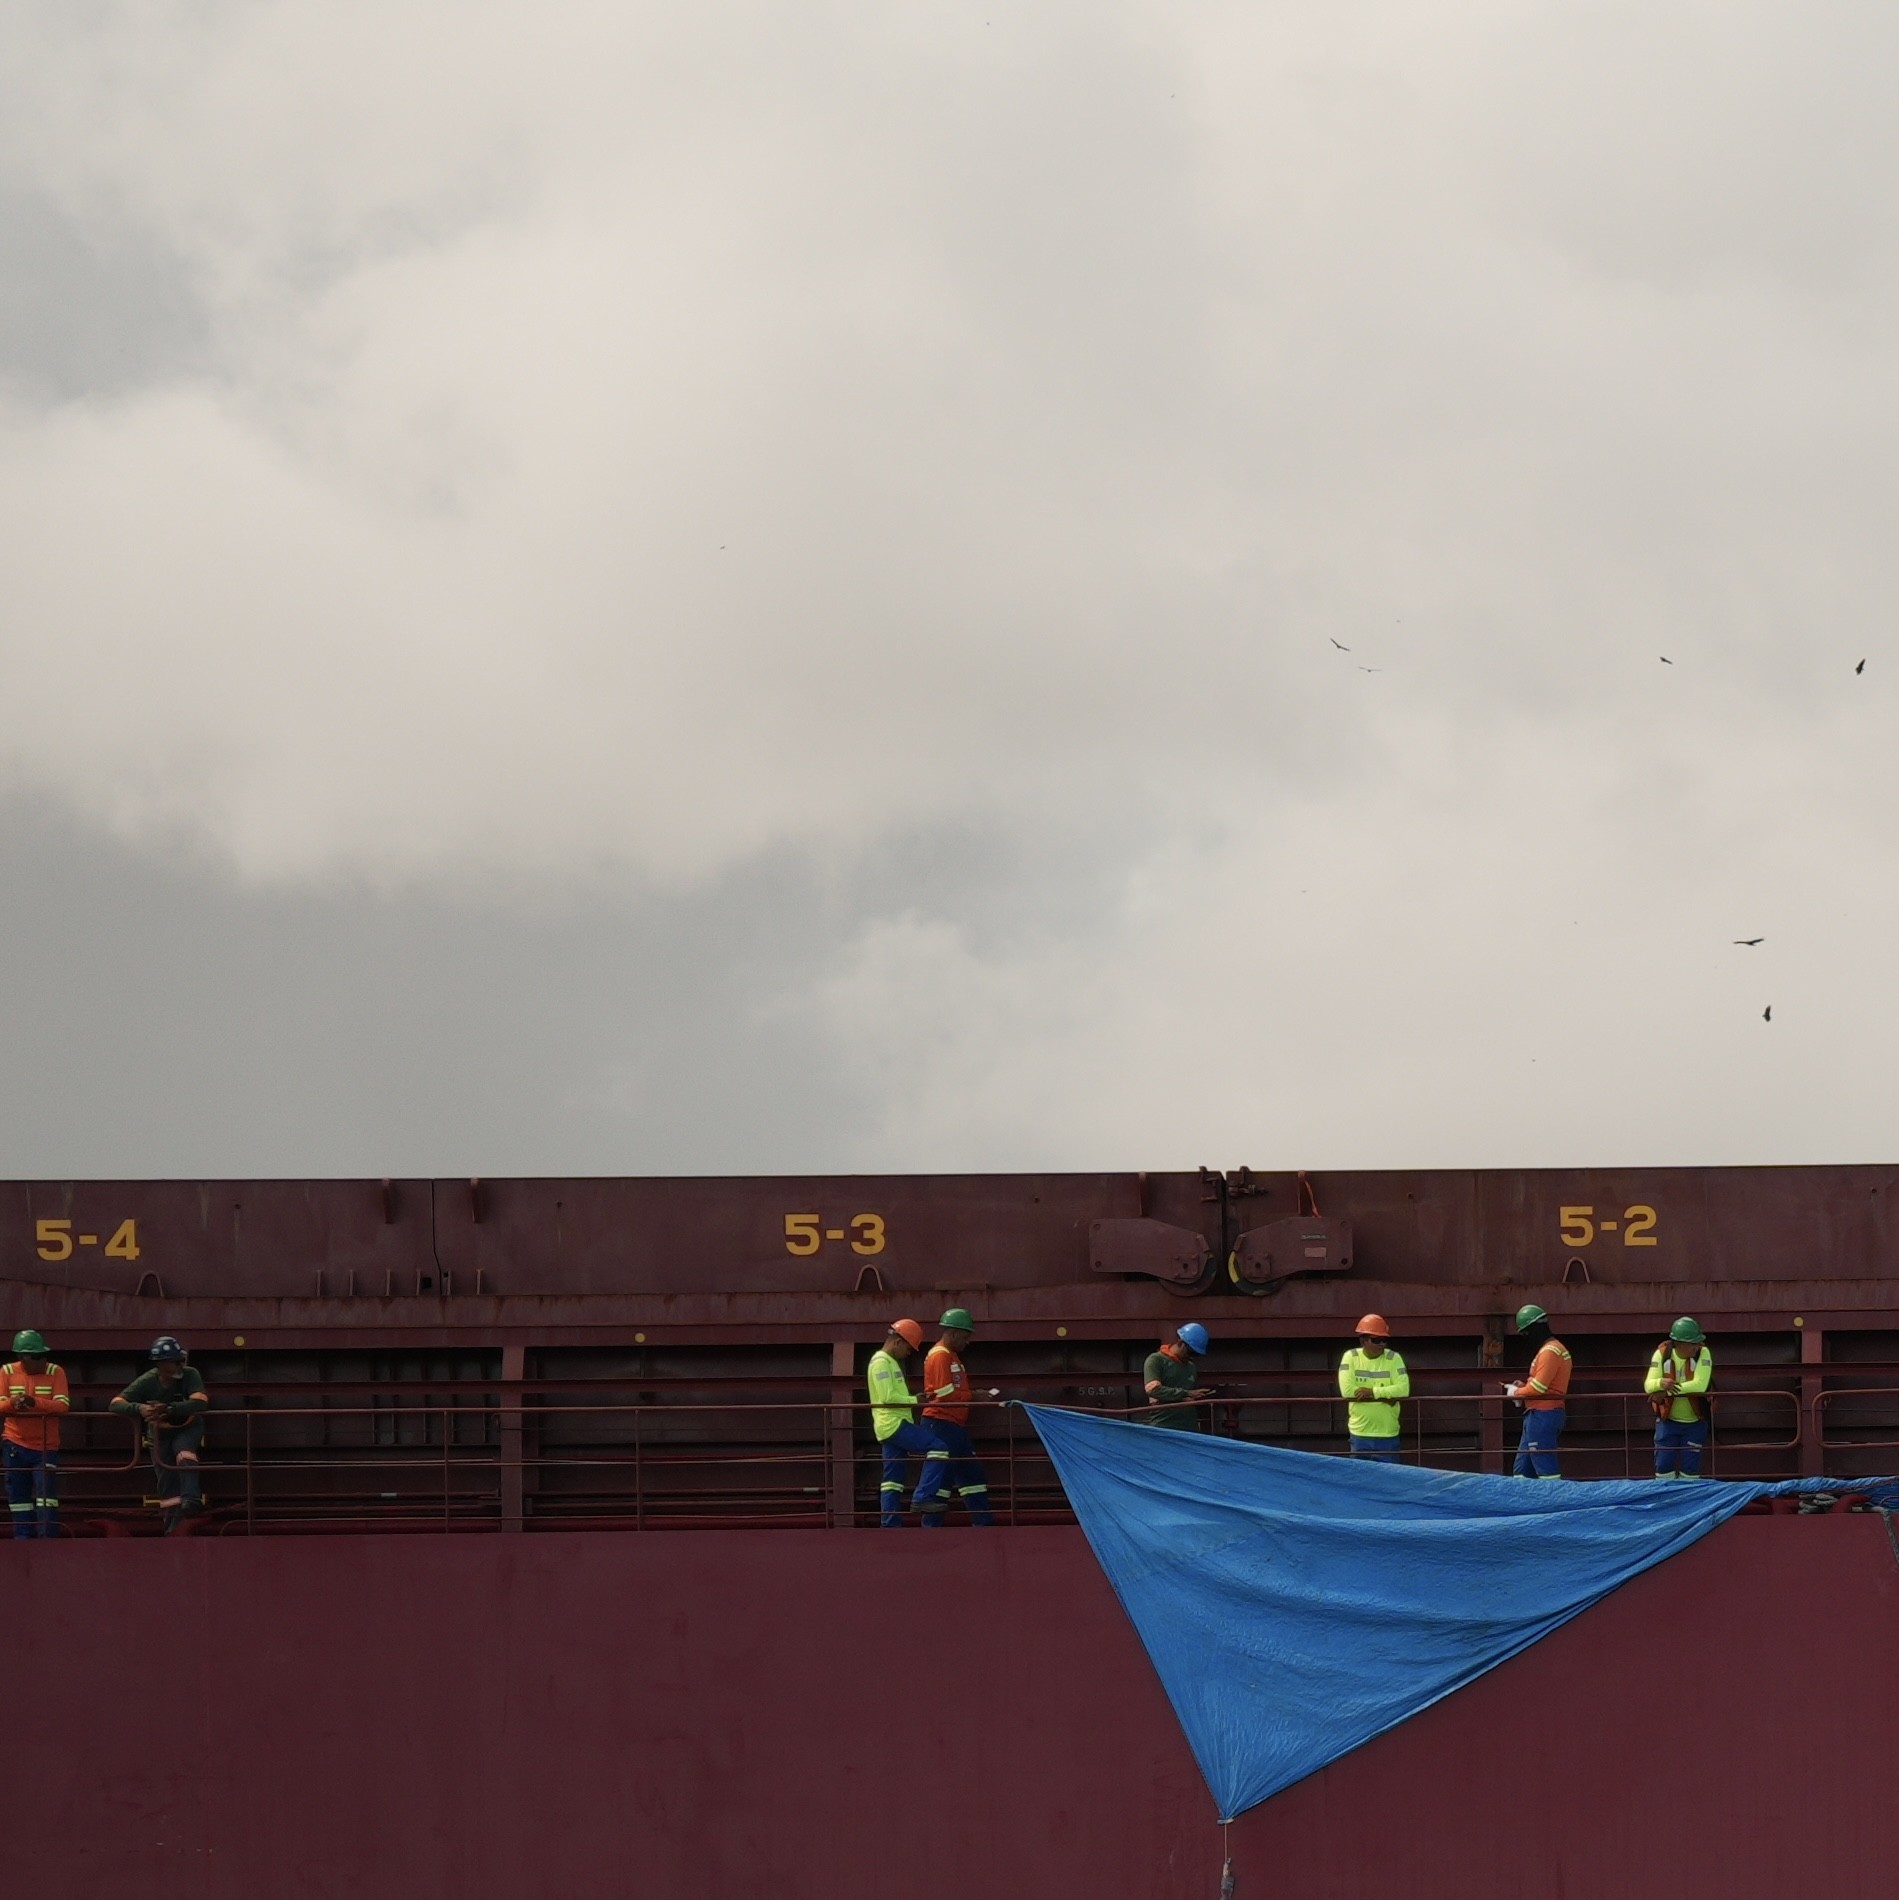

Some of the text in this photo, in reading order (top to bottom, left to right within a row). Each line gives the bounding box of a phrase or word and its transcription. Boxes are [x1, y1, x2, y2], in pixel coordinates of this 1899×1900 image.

[36, 1219, 140, 1262] 5-4
[784, 1213, 886, 1256] 5-3
[1559, 1205, 1658, 1247] 5-2
